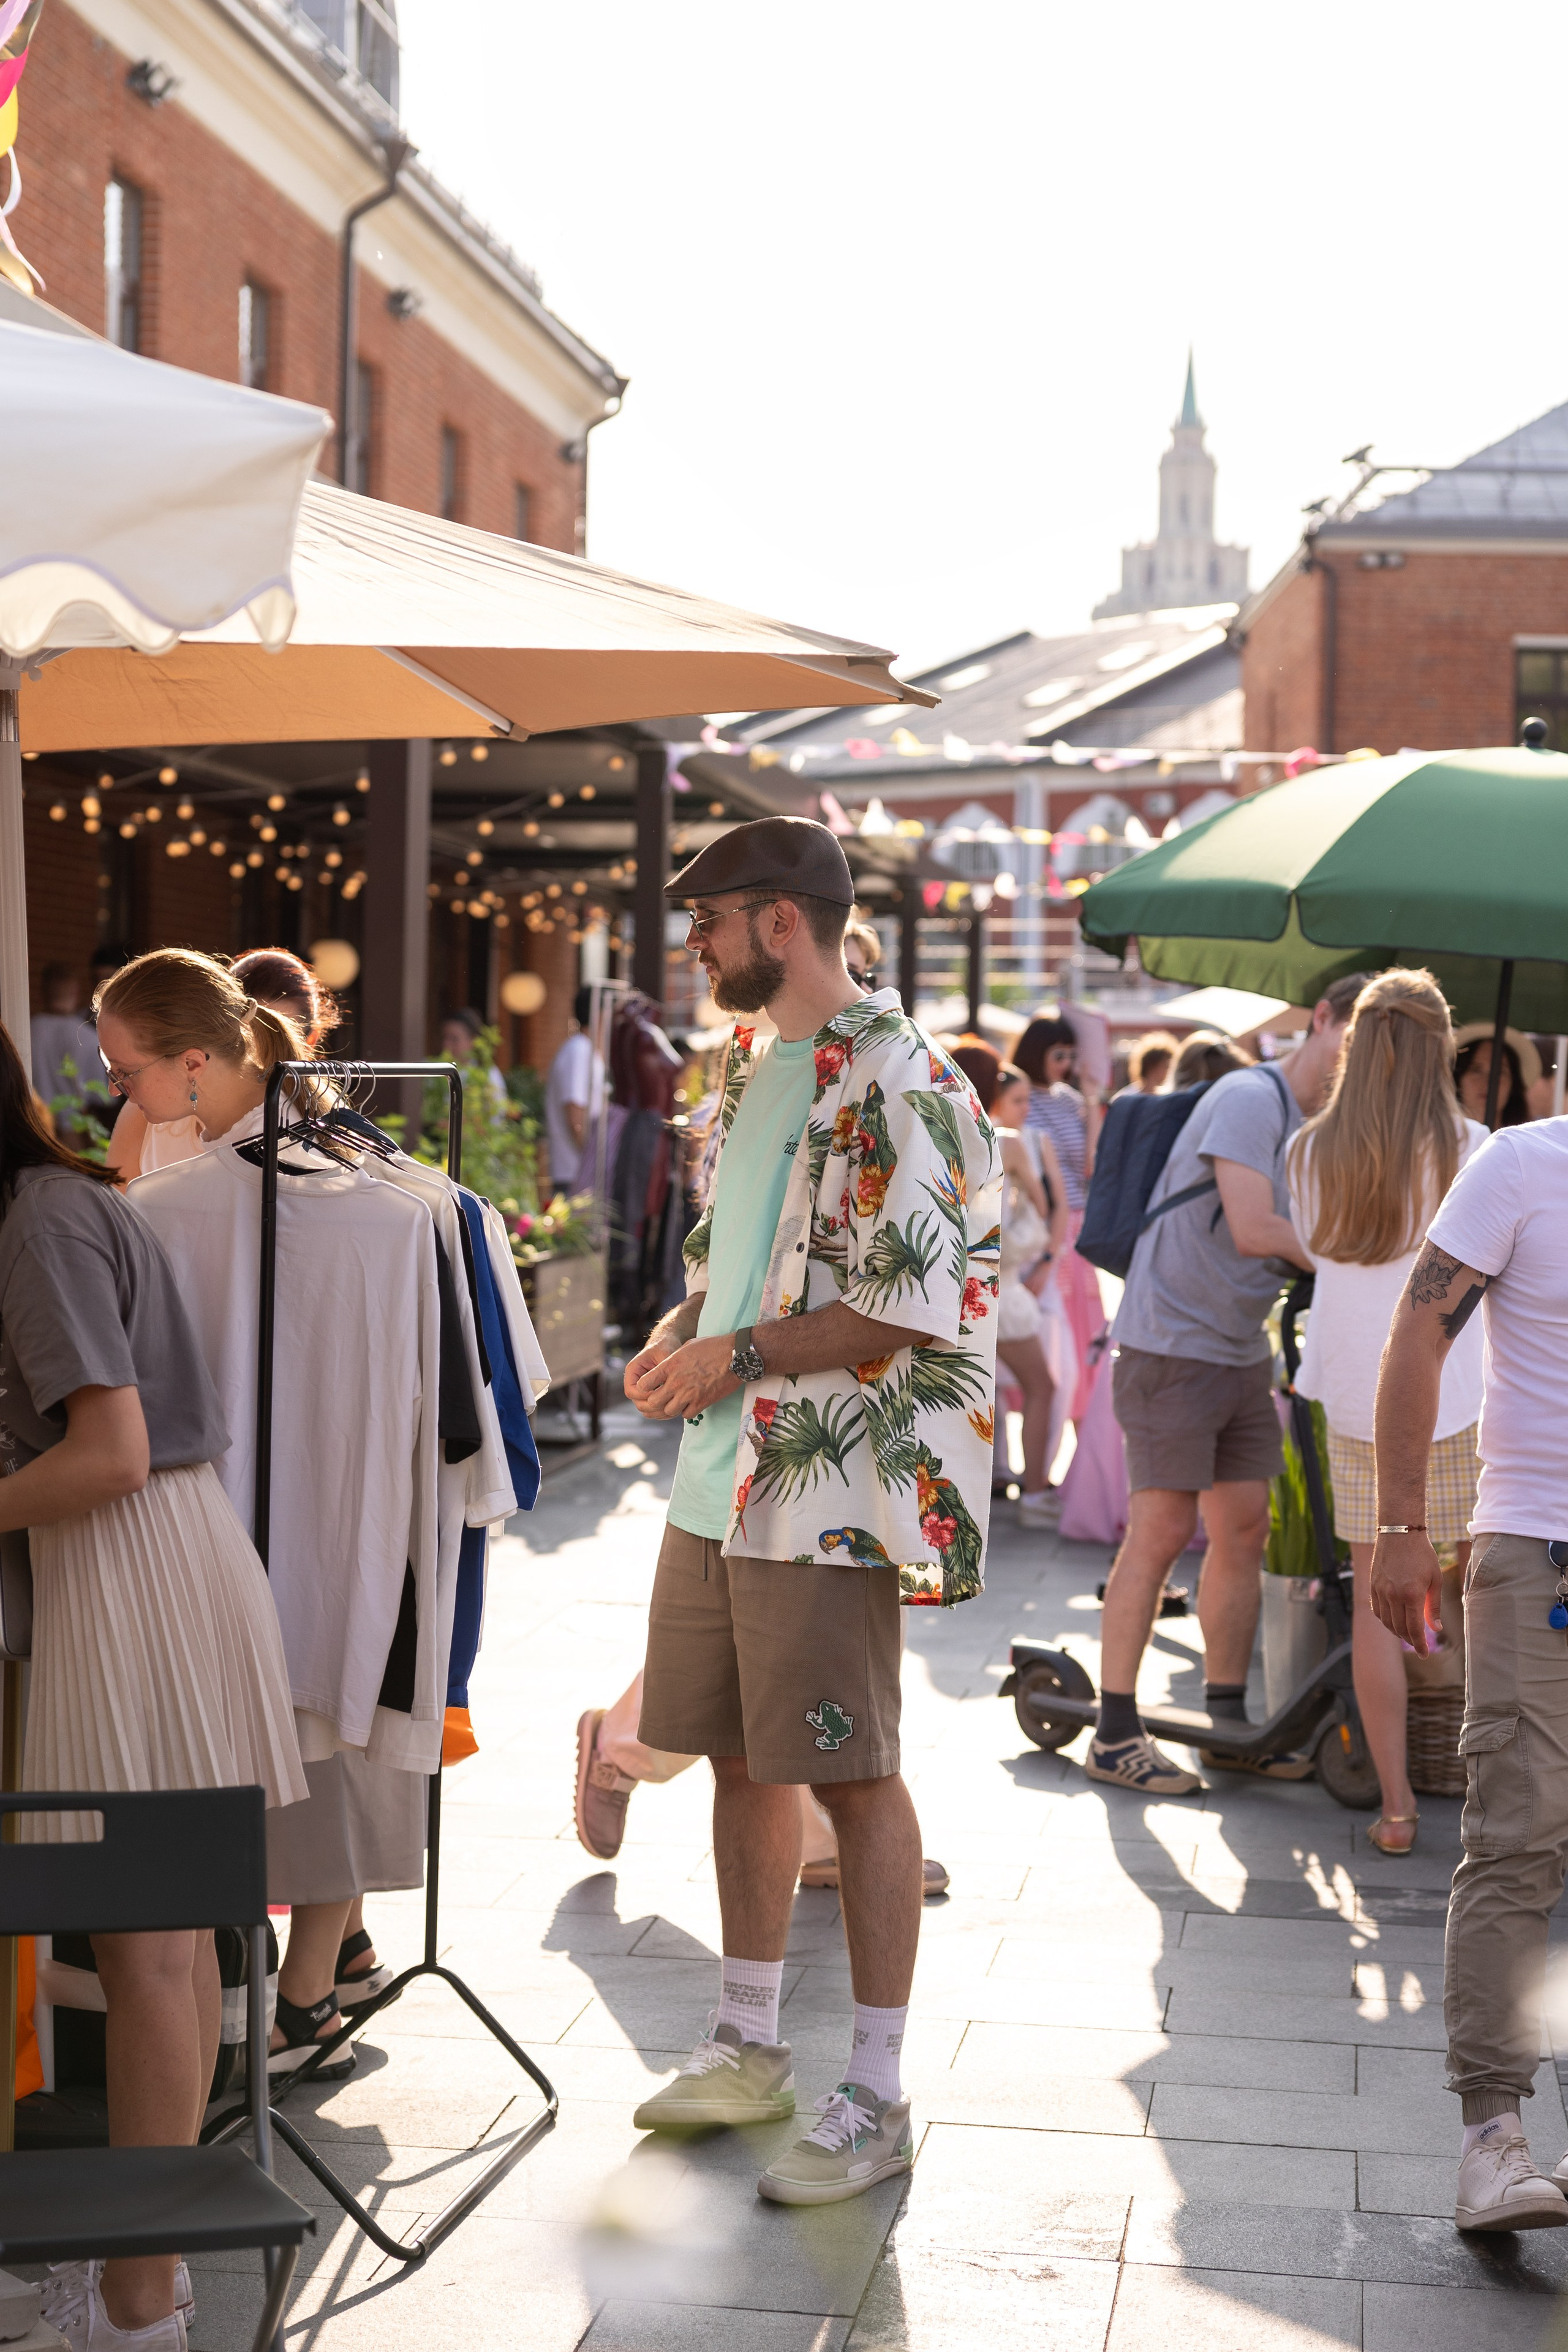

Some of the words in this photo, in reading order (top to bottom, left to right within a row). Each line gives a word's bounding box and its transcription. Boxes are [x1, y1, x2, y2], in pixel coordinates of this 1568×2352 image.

[723, 1980, 776, 1993] BROKEN
[723, 1987, 775, 2001] HEARTS
[729, 1996, 767, 2007] CLUB
[1480, 2124, 1499, 2139] adidas
